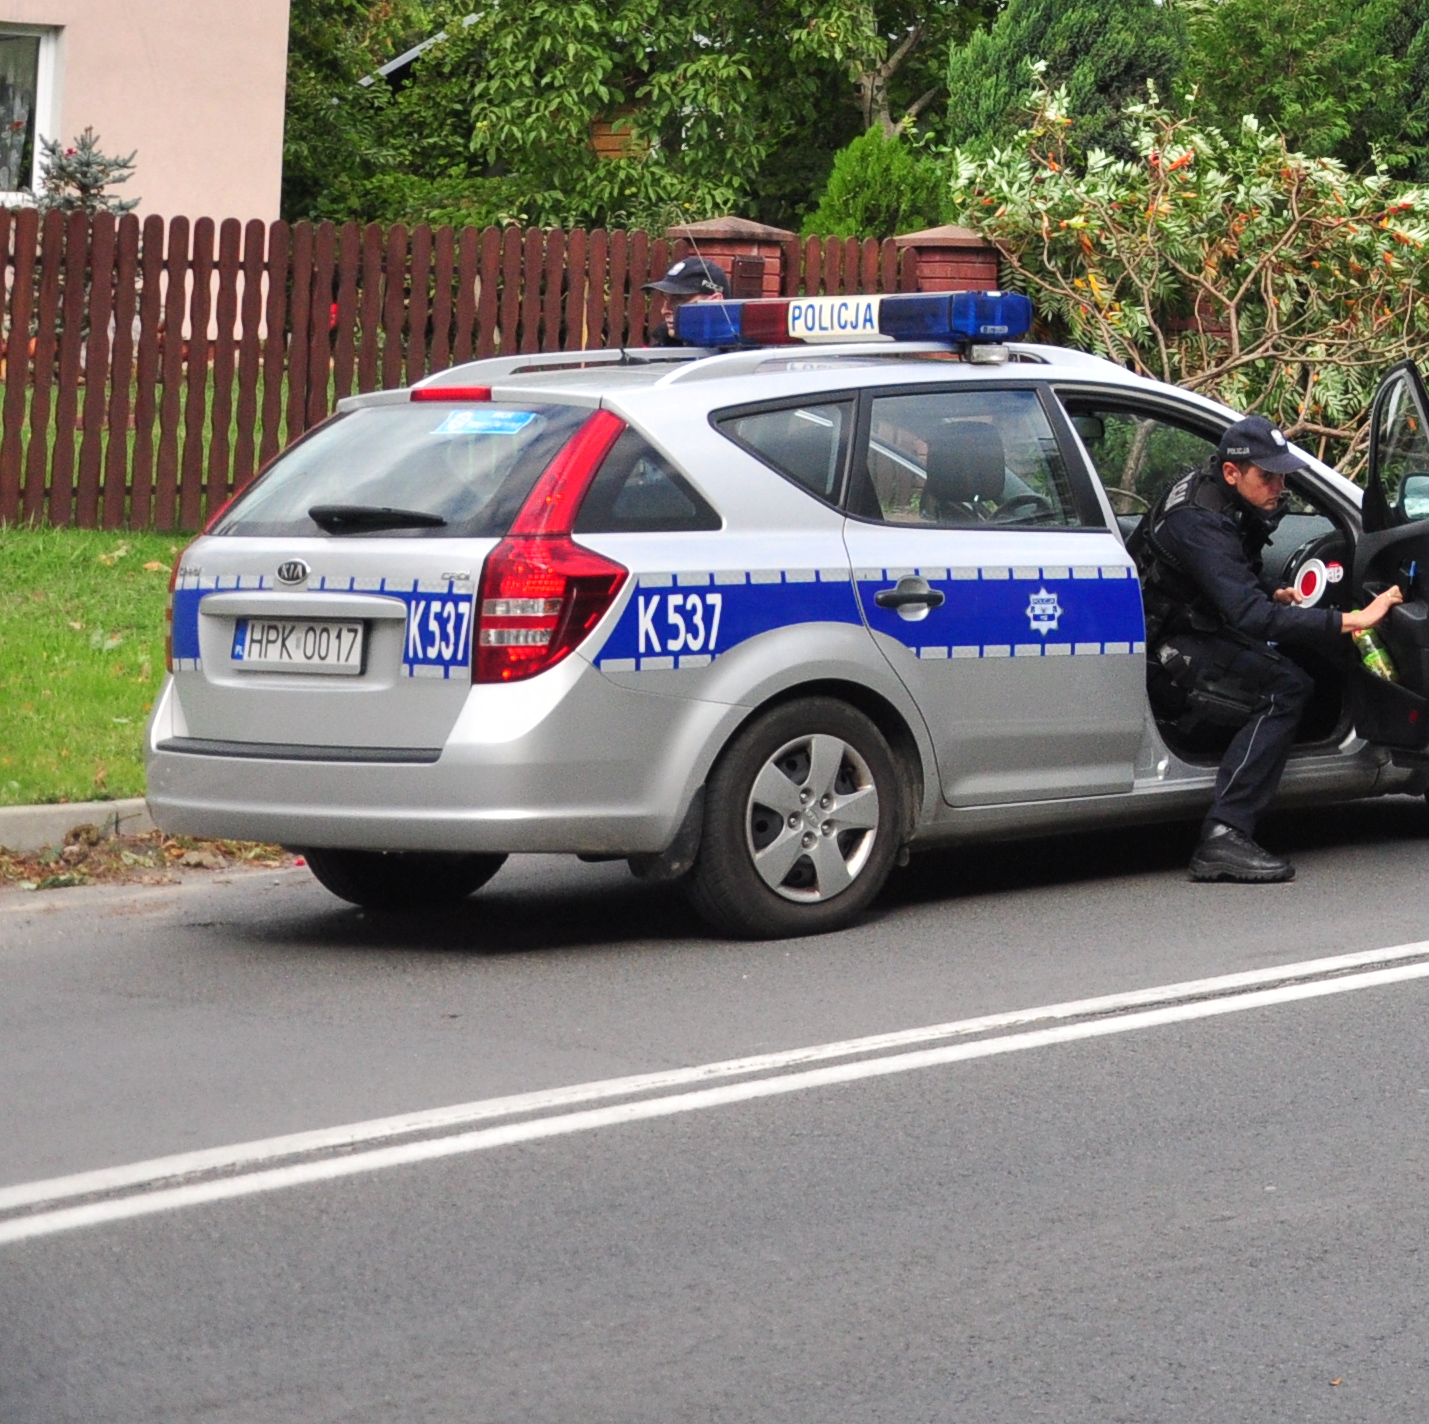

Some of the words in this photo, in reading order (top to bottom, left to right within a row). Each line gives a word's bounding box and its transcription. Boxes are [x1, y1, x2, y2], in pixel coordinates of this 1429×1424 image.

[791, 302, 875, 332] POLICJA
[280, 564, 303, 579] KIA
[248, 624, 296, 660] HPK
[303, 626, 359, 662] 0017
